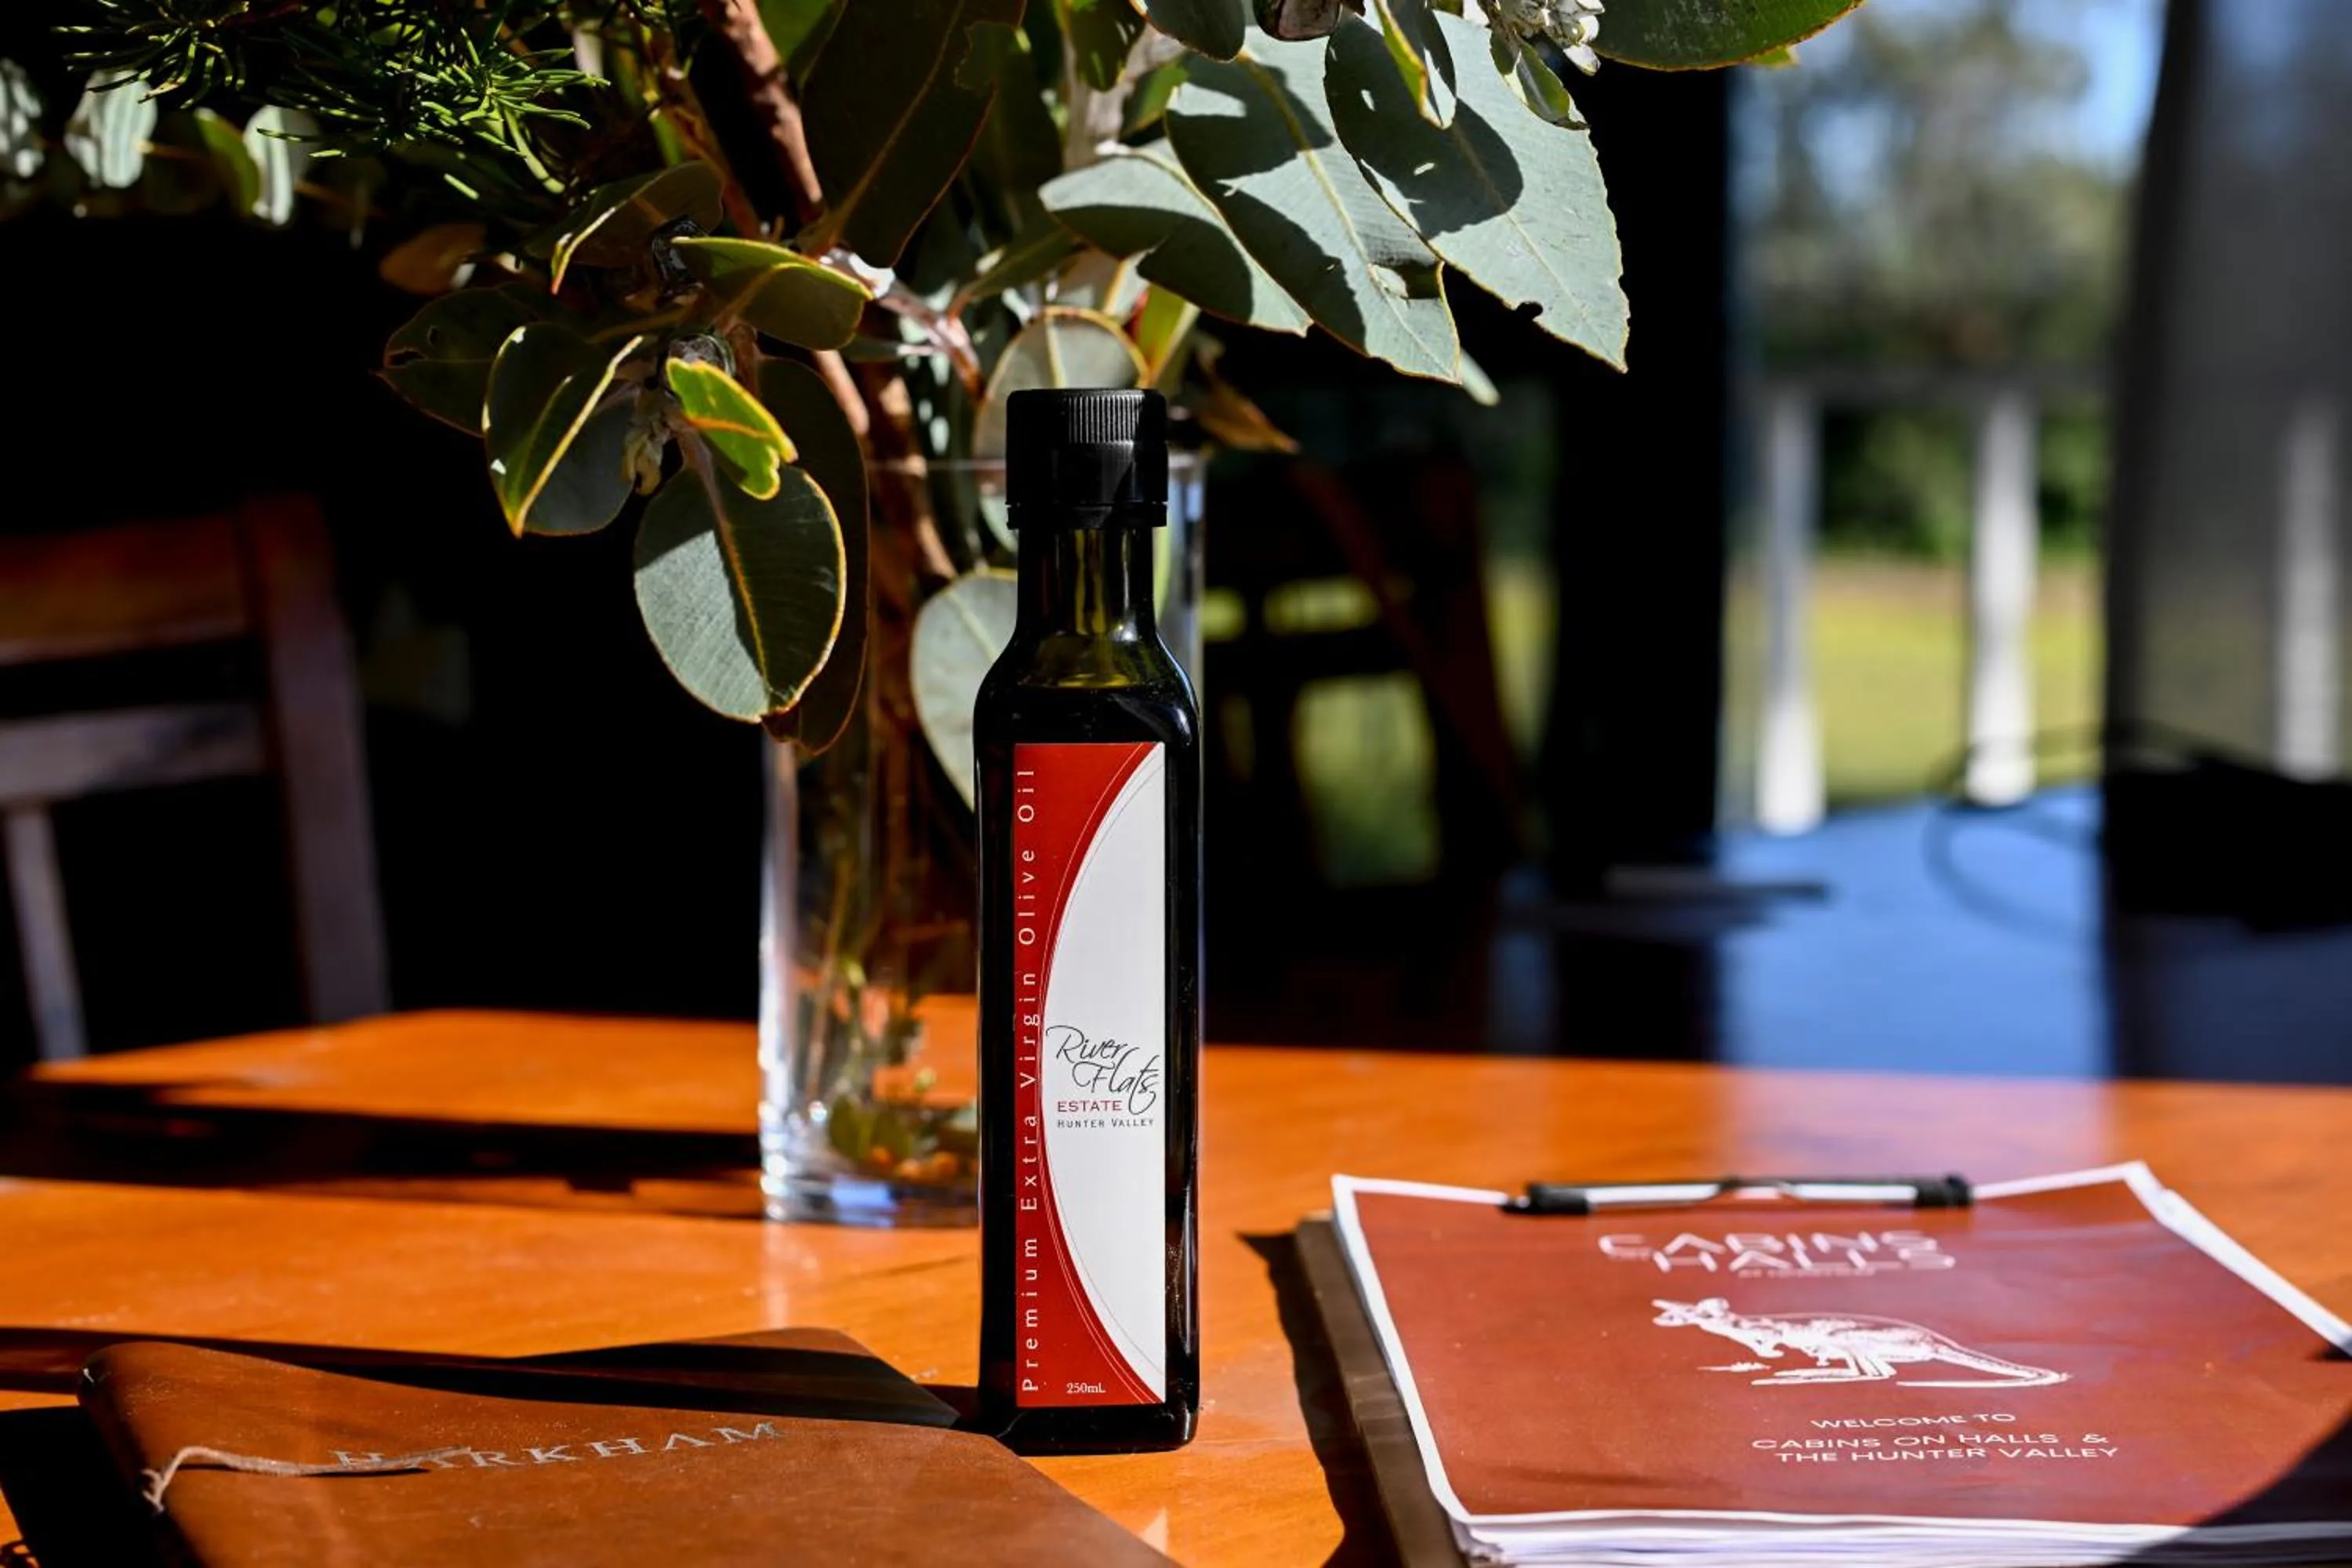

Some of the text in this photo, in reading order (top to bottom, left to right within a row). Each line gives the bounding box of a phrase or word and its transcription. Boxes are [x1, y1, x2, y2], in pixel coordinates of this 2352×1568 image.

[1045, 1025, 1128, 1064] River
[1017, 770, 1041, 1392] Premium Extra Virgin Olive Oil
[1072, 1047, 1161, 1116] Flats
[1057, 1100, 1123, 1112] ESTATE
[1057, 1118, 1155, 1128] HUNTER VALLEY
[1598, 1231, 1938, 1258] CABINS
[1652, 1248, 1956, 1273] HALLS
[1065, 1381, 1107, 1394] 250mL
[1809, 1413, 2016, 1428] WELCOME TO
[1751, 1432, 2110, 1449] CABINS ON HALLS &
[1774, 1447, 2118, 1463] THE HUNTER VALLEY
